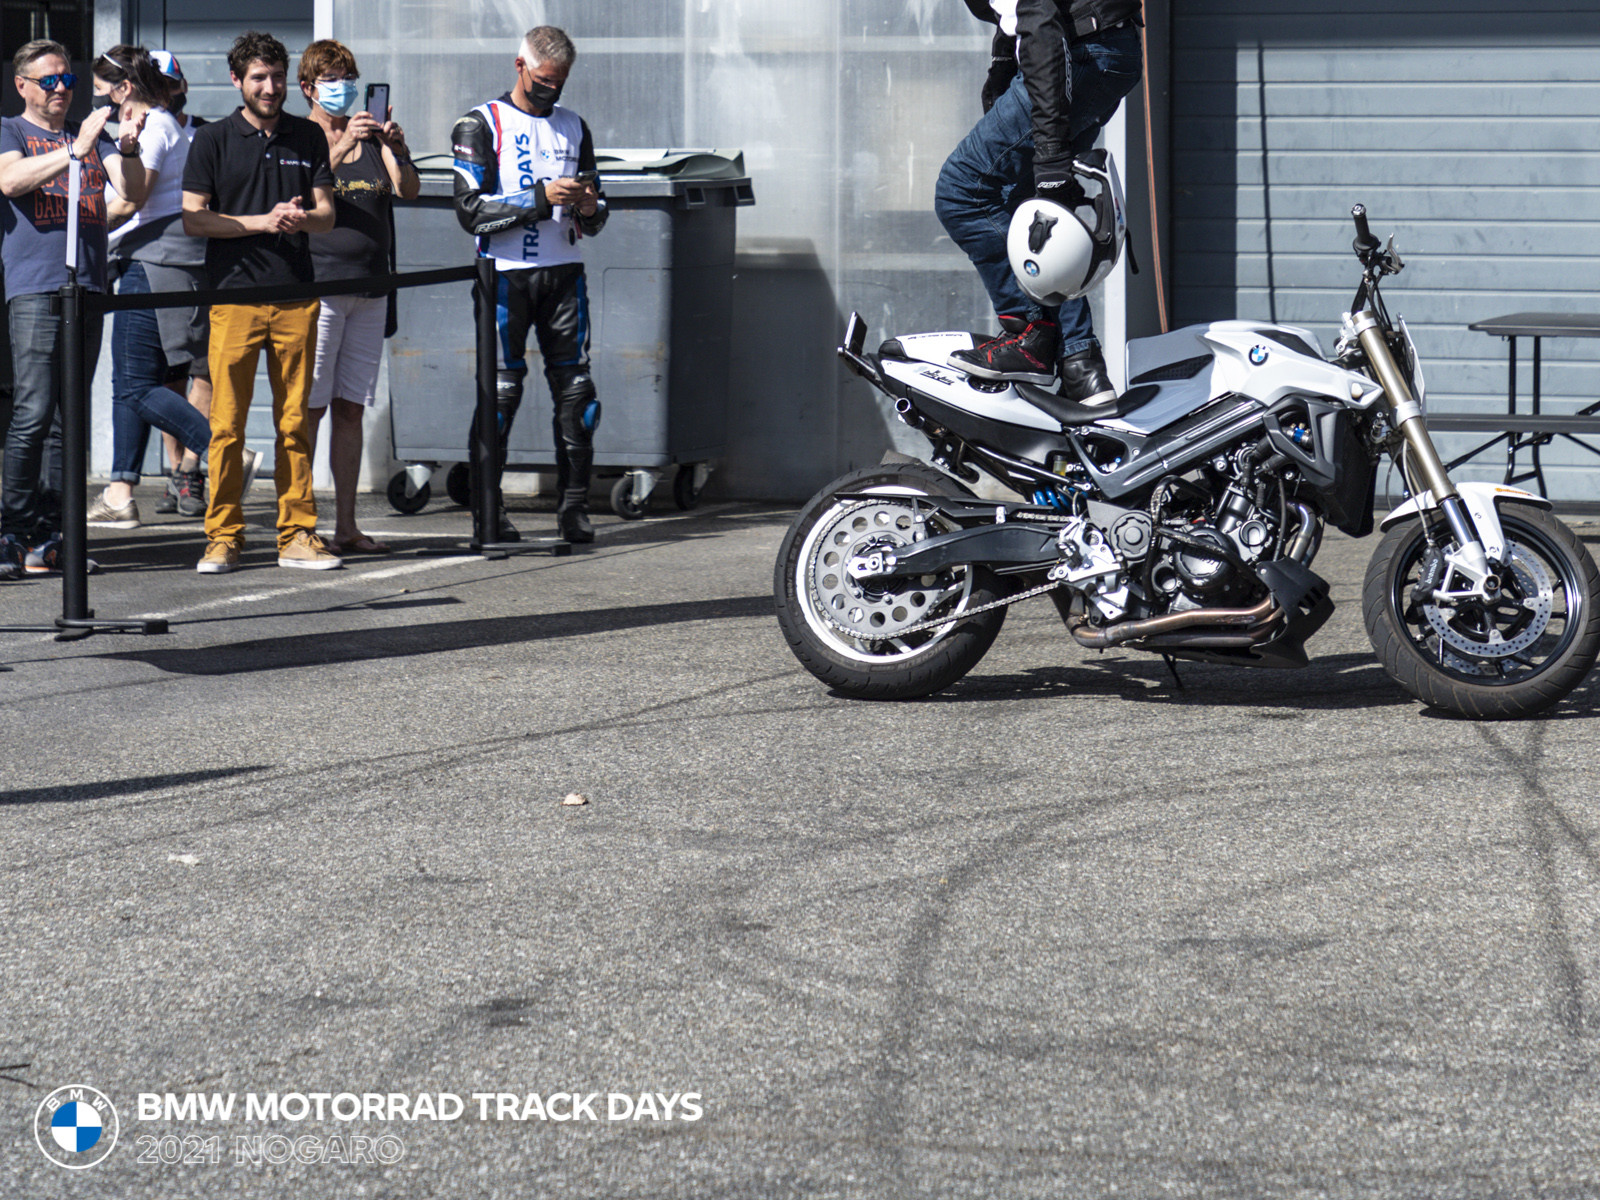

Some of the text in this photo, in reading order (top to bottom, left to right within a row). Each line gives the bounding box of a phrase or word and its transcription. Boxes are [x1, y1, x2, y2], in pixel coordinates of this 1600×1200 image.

[474, 216, 517, 234] RST
[515, 133, 539, 260] TRA DAYS
